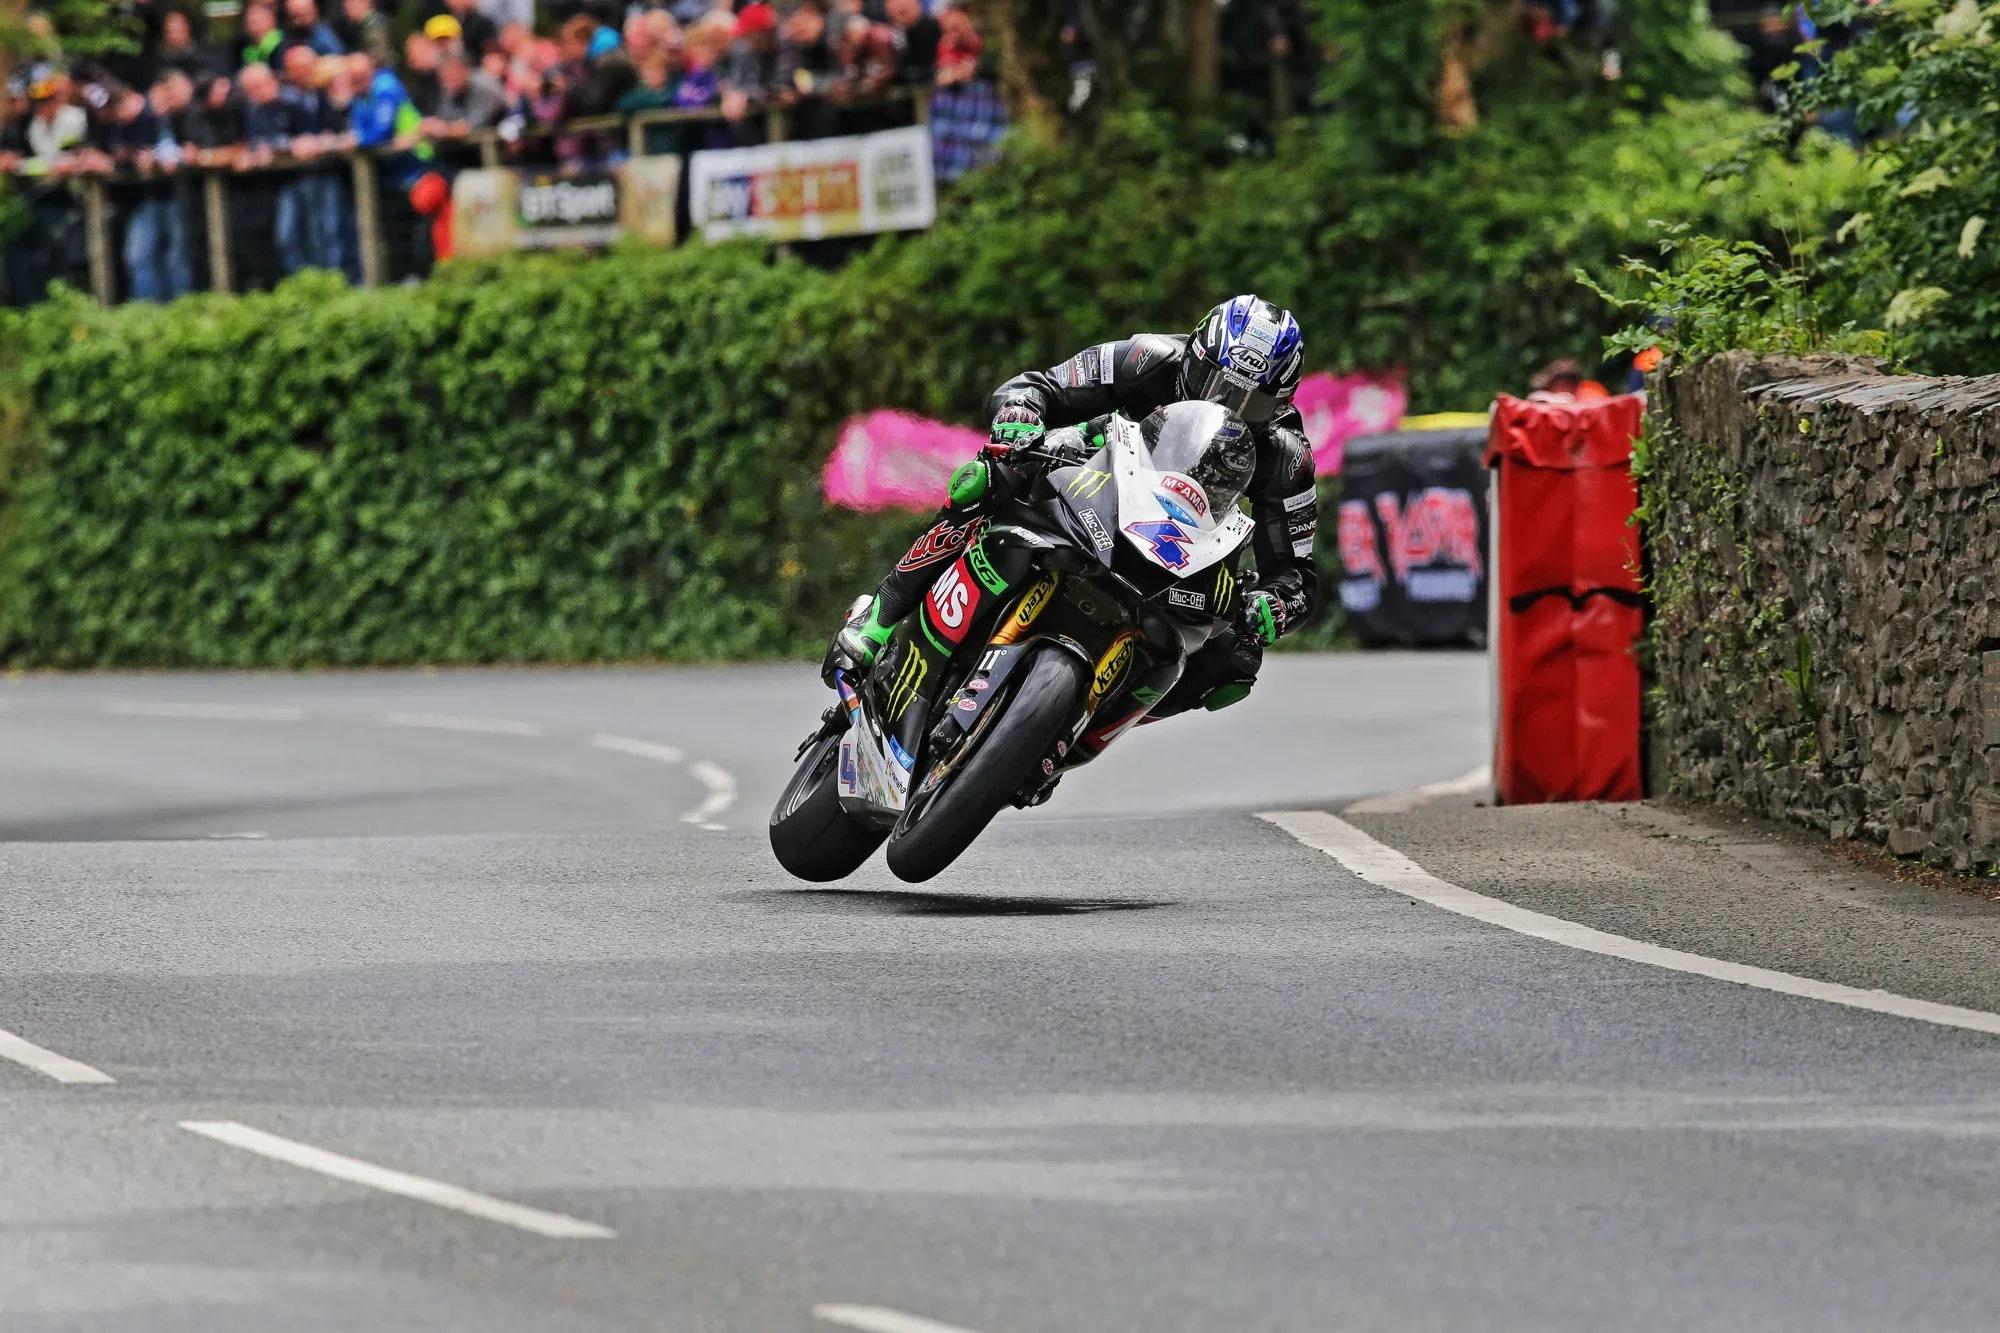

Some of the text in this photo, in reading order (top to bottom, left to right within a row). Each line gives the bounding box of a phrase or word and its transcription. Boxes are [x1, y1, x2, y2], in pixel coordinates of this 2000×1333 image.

[1250, 326, 1277, 343] hager
[1229, 346, 1265, 370] Arai
[1222, 366, 1260, 387] MANNINGHAM
[1162, 477, 1205, 514] McAMS
[1081, 509, 1112, 549] Muc-Off
[1124, 521, 1194, 571] 4
[1171, 591, 1203, 608] Muc-Off
[960, 699, 976, 710] sbs
